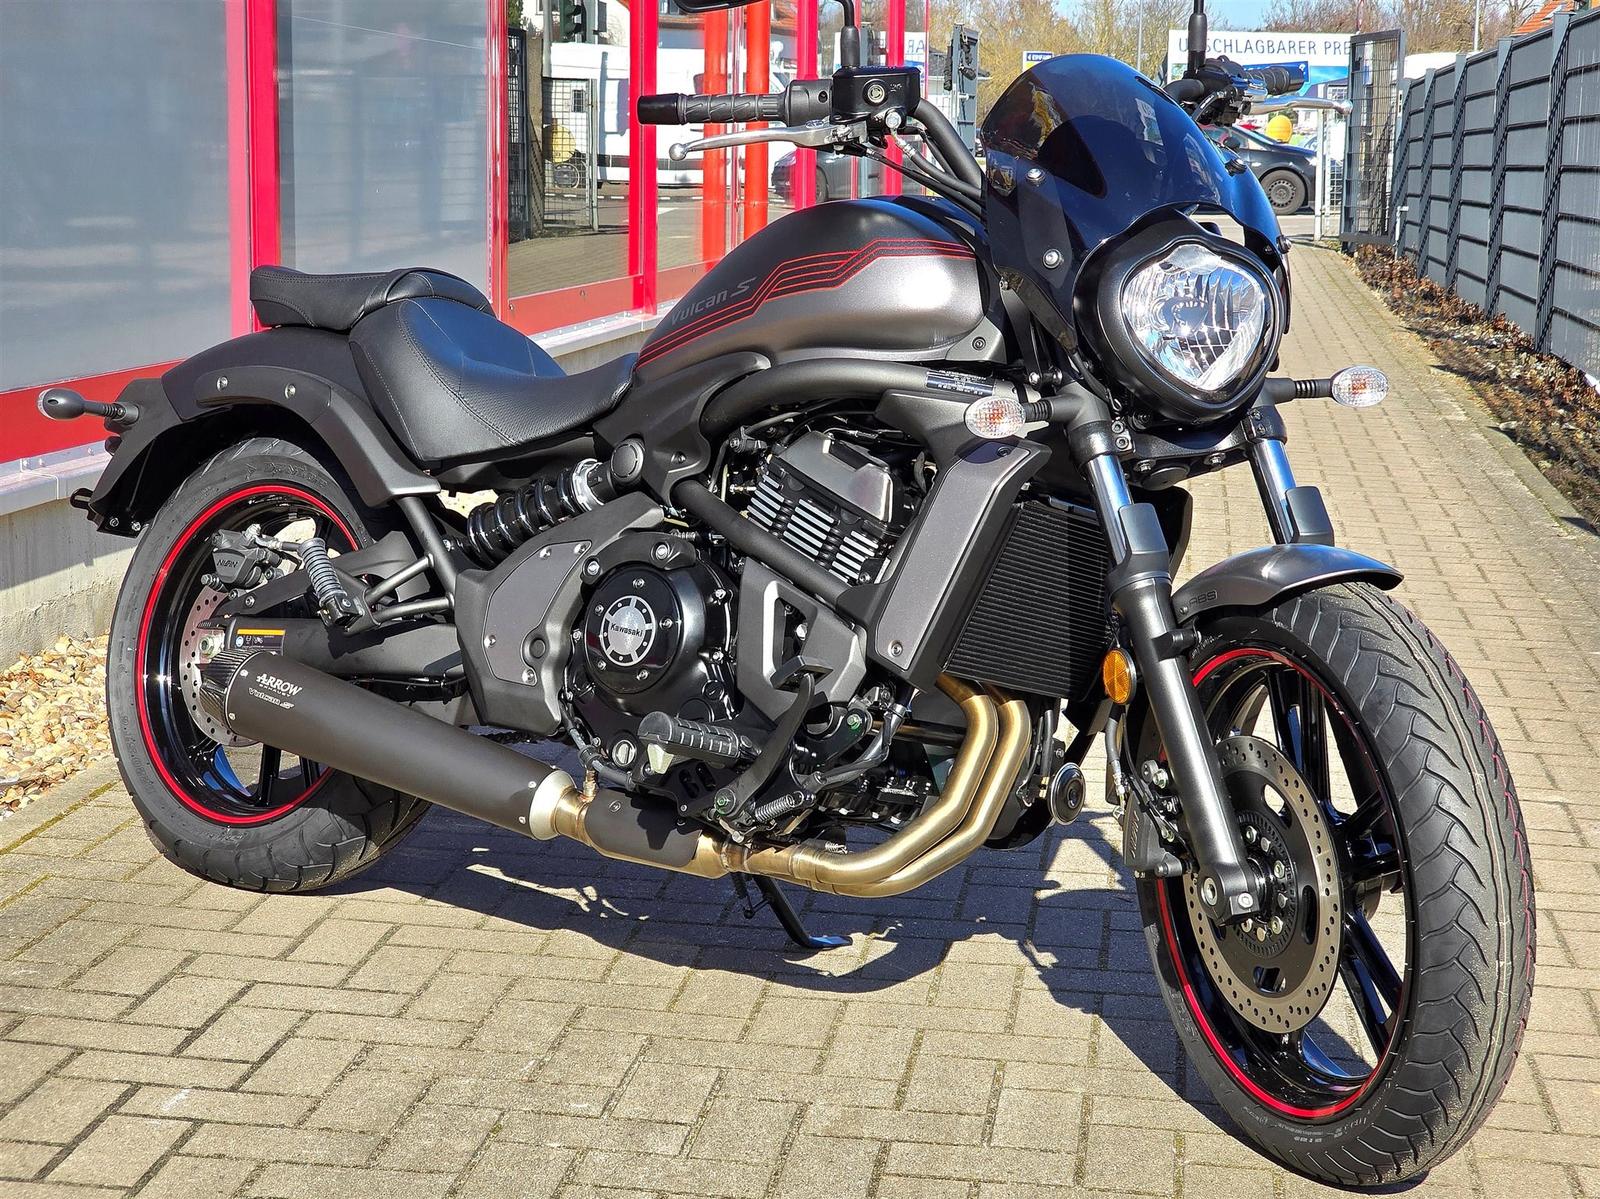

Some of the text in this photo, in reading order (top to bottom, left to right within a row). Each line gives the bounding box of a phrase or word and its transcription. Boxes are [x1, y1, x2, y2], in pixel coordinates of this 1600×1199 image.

[1178, 37, 1316, 55] USCHLAGBARER
[671, 276, 758, 325] Vulcan S
[1188, 590, 1217, 605] ABS
[610, 621, 644, 637] Kawasaki
[255, 673, 303, 696] ARROW
